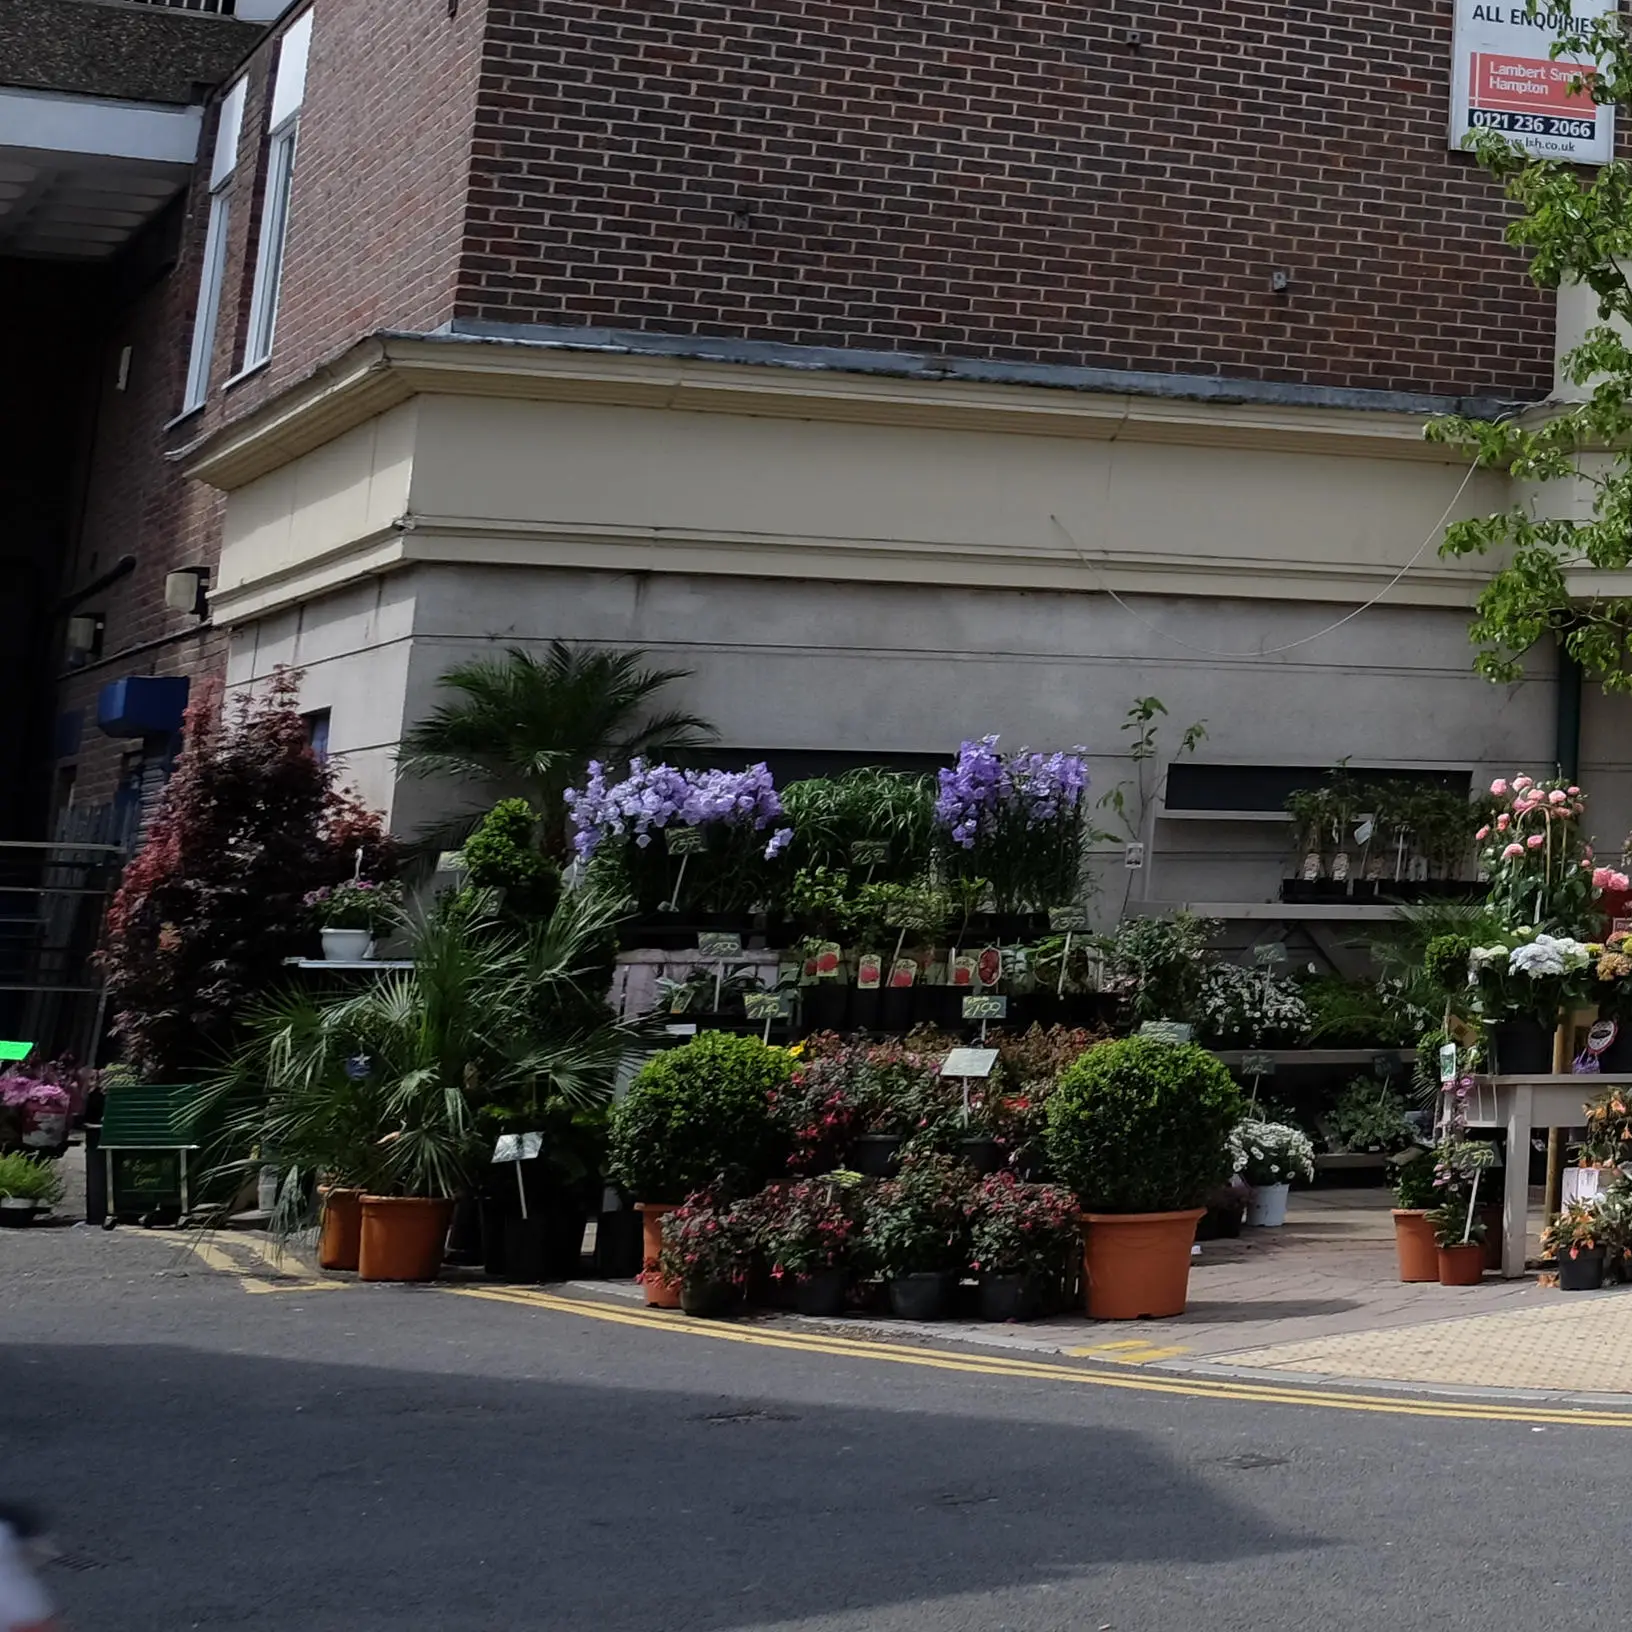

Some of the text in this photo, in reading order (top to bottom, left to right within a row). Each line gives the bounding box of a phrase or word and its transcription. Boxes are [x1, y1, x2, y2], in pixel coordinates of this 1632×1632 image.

[1472, 5, 1504, 23] ALL
[1490, 61, 1546, 80] Lambert
[1489, 76, 1549, 95] Hampton
[1473, 112, 1591, 137] 0121 236 2066
